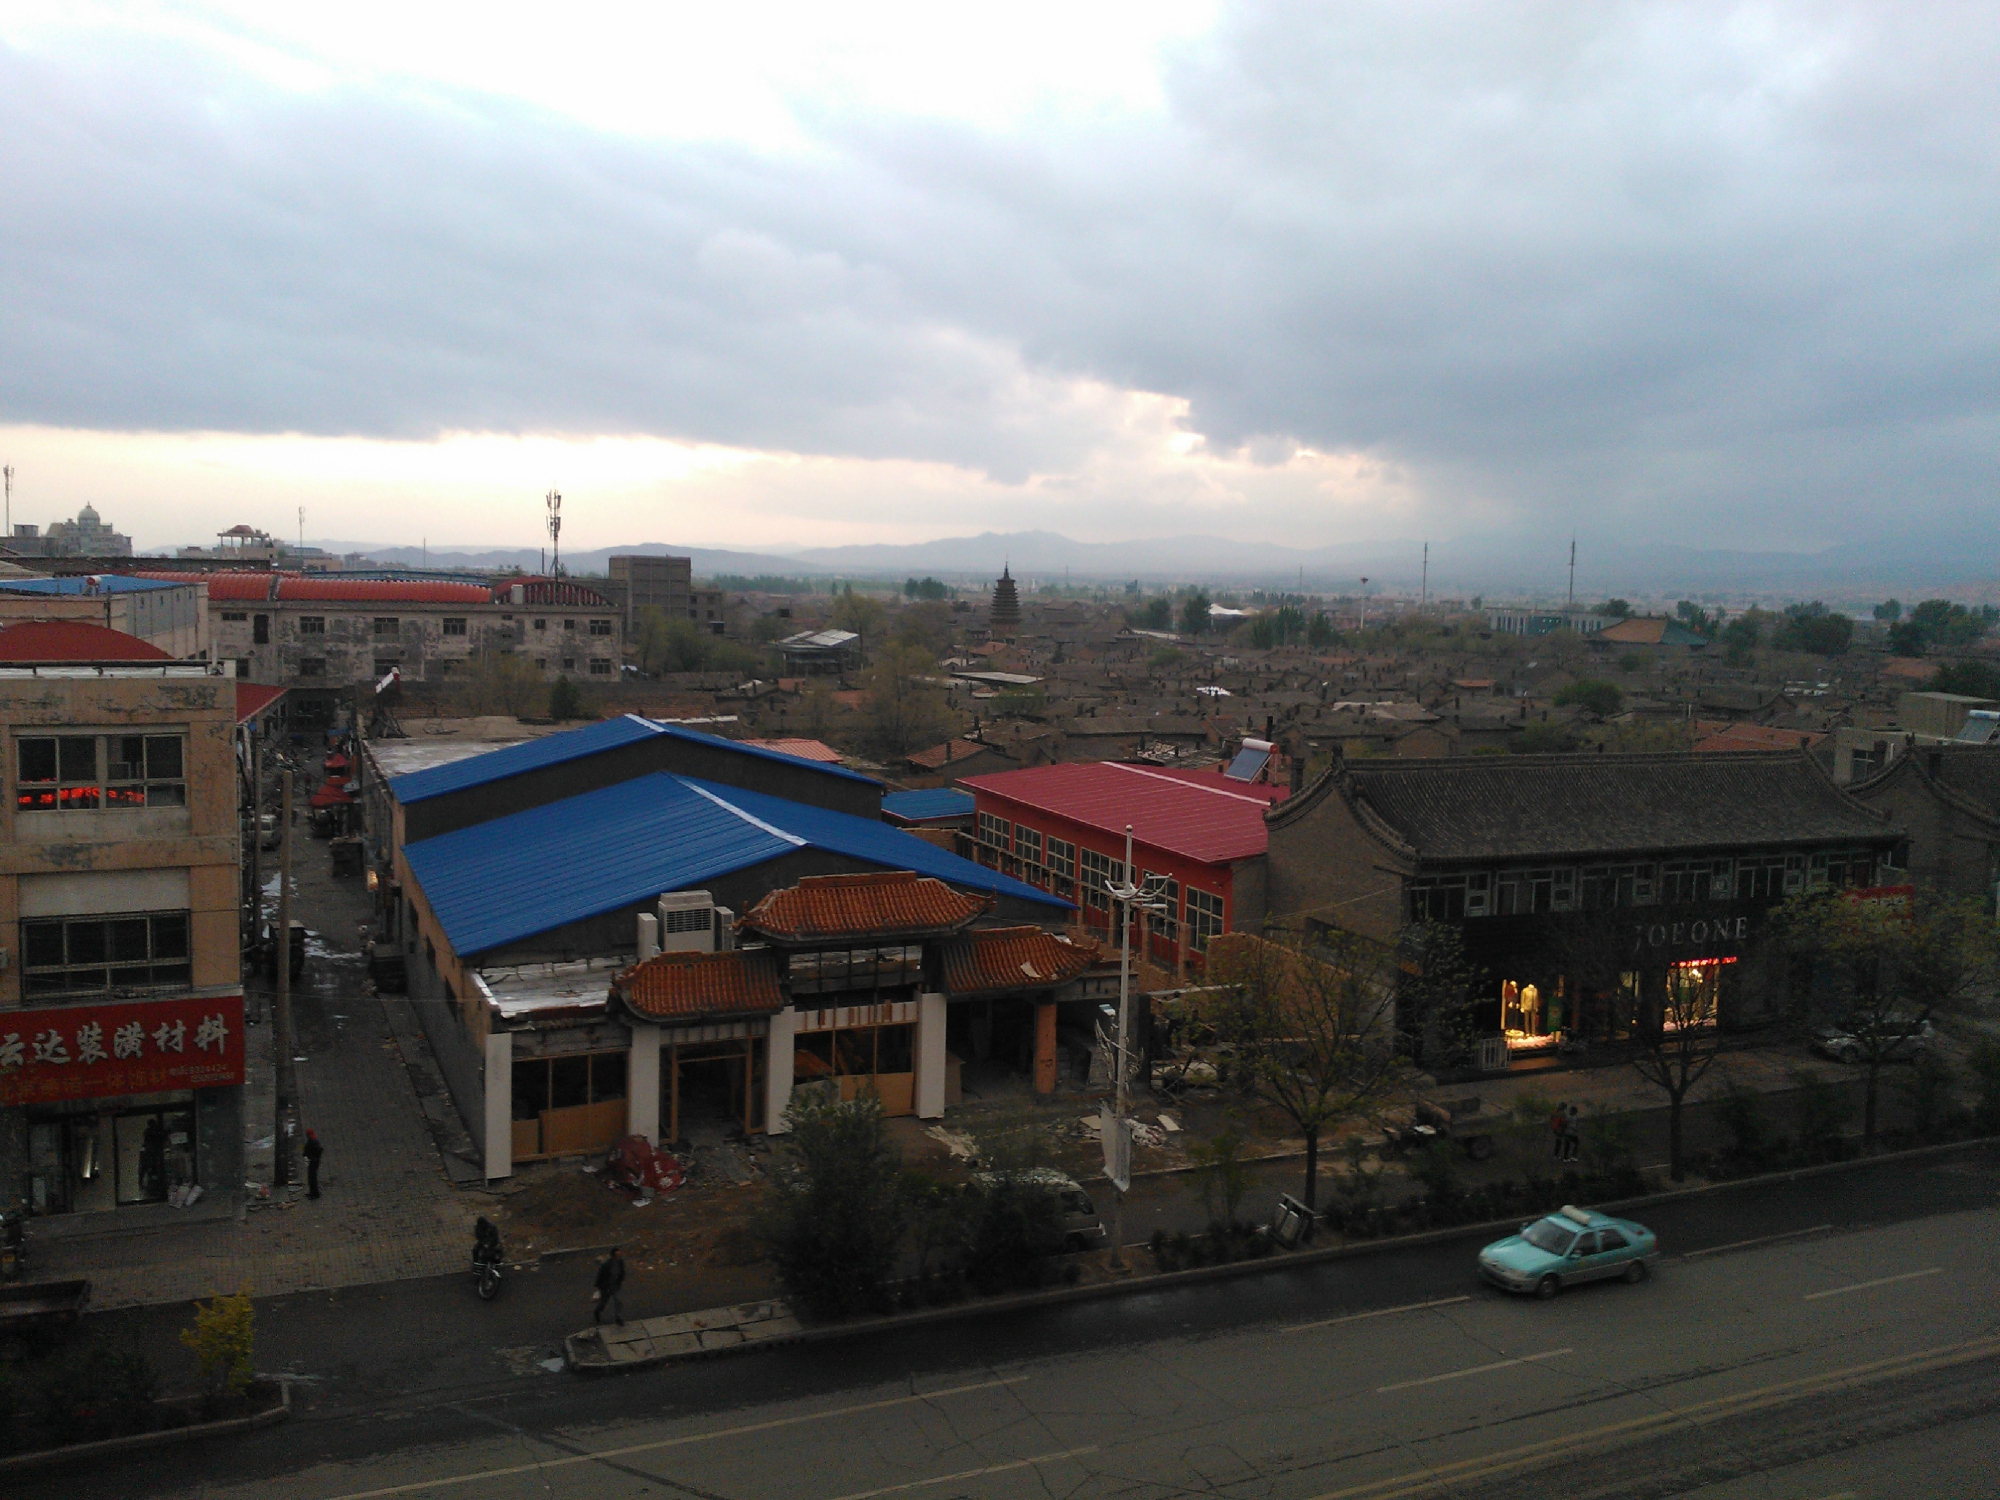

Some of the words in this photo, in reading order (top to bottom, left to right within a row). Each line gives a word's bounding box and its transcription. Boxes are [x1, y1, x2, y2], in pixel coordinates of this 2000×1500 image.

[0, 1012, 229, 1067] 云达装潢材料
